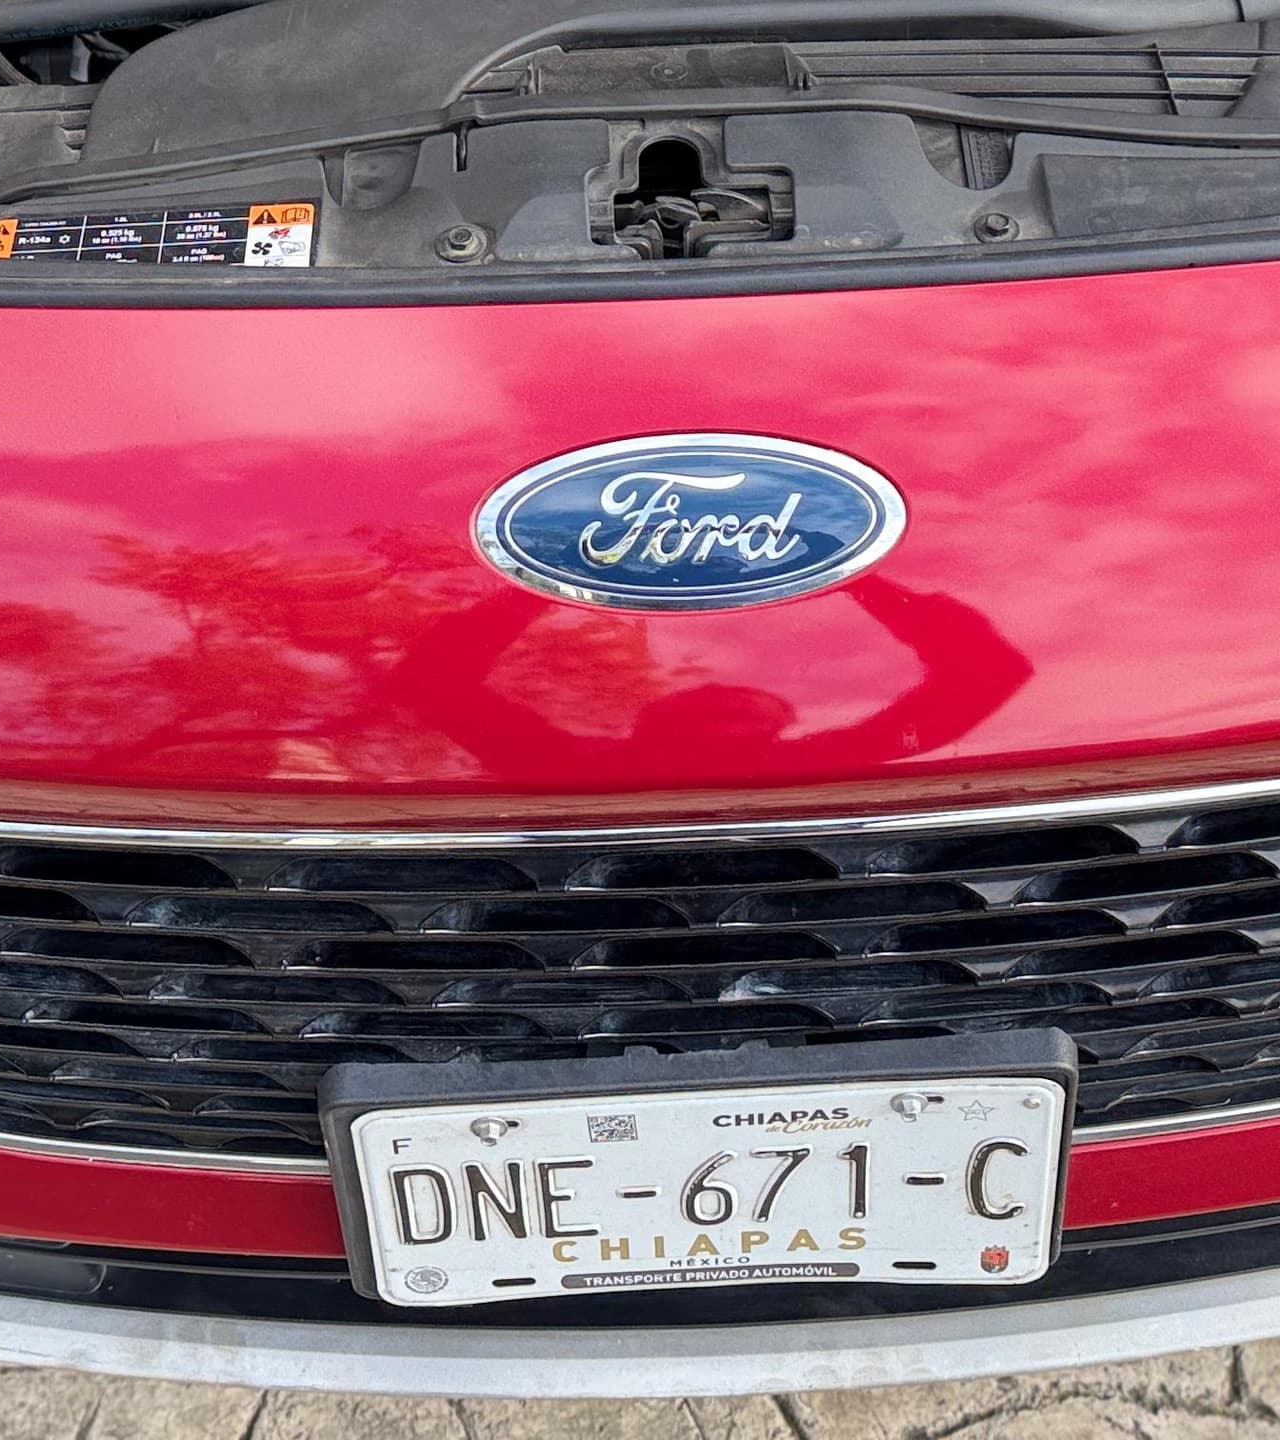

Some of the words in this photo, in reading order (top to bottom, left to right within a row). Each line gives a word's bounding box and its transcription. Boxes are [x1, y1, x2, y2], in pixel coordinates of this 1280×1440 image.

[18, 236, 52, 245] R-134a
[580, 471, 802, 568] Ford
[712, 1106, 850, 1128] CHIAPAS
[782, 1116, 873, 1134] Corazón
[391, 1137, 413, 1155] F
[552, 1226, 868, 1263] CHIAPAS
[669, 1255, 751, 1268] MÉXICO
[583, 1272, 683, 1288] TRANSPORTE
[685, 1268, 750, 1282] PRIVADO
[752, 1263, 838, 1278] AUTOMÓVIL
